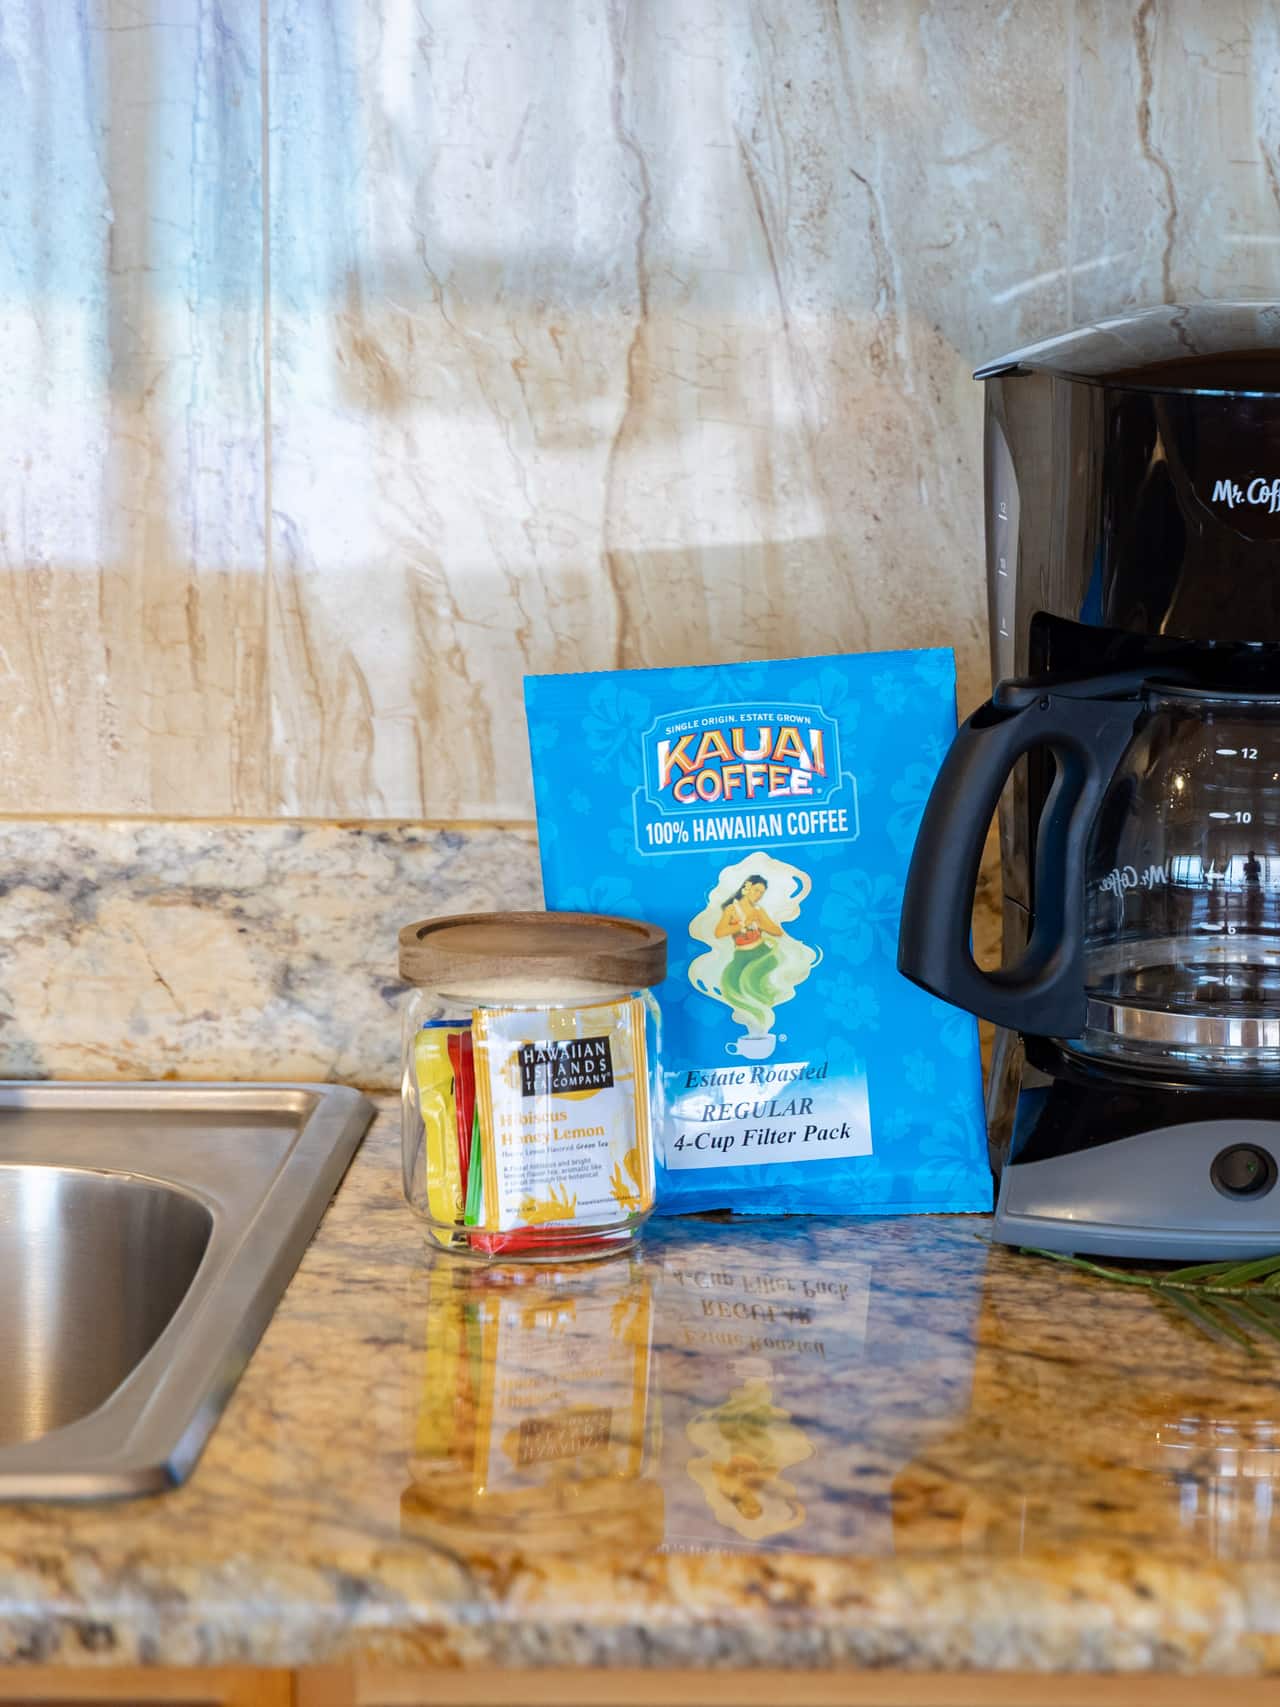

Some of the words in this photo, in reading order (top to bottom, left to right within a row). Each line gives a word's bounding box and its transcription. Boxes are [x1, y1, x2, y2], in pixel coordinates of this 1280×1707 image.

[1211, 479, 1245, 509] Mr.
[665, 720, 700, 735] SINGLE
[740, 713, 775, 722] ESTATE
[776, 714, 812, 725] GROWN
[657, 726, 828, 792] KAUAI
[1241, 747, 1258, 760] 12
[672, 763, 814, 804] COFFEE
[646, 819, 689, 846] 100%
[693, 813, 783, 843] HAWAIIAN
[787, 809, 849, 836] COFFEE
[1234, 811, 1252, 824] 10
[1227, 924, 1236, 935] 6
[1225, 974, 1233, 986] 4
[523, 1041, 606, 1064] HAWAIIAN
[525, 1058, 608, 1080] ISLANDS
[684, 1069, 746, 1089] Estate
[749, 1061, 829, 1085] Roasted
[553, 1073, 607, 1088] COMPANY
[500, 1111, 568, 1127] Hbiscus
[701, 1097, 814, 1122] REGULAR
[501, 1132, 549, 1147] Hney
[553, 1125, 605, 1142] Lemon
[673, 1131, 735, 1153] 4-Cup
[741, 1128, 797, 1147] Filter
[803, 1122, 852, 1142] Pack
